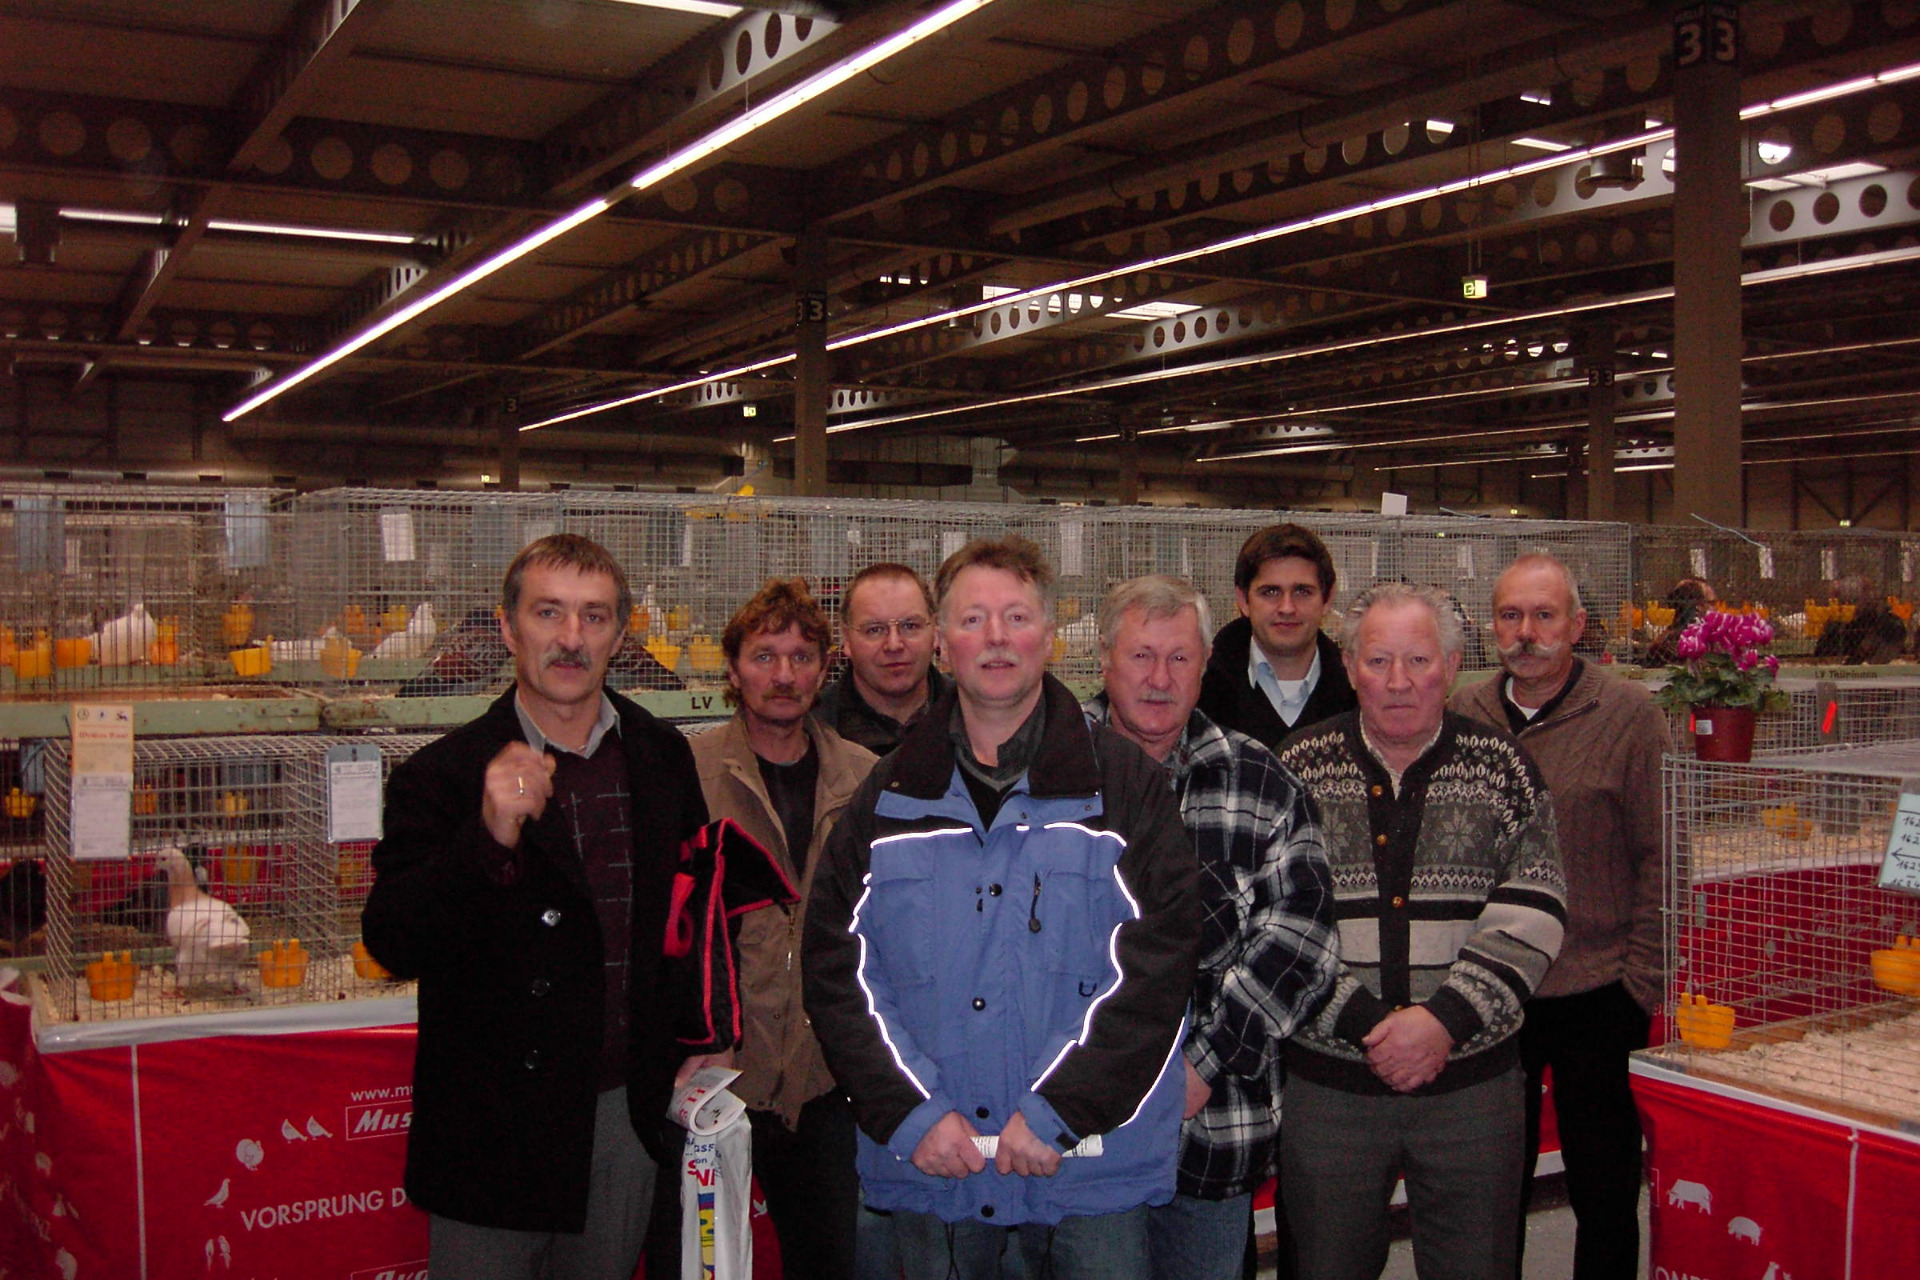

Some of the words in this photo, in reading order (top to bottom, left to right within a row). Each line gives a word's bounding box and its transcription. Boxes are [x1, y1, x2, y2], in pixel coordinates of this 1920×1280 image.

[810, 300, 823, 320] 3
[691, 696, 713, 710] LV
[240, 1189, 384, 1231] VORSPRUNG
